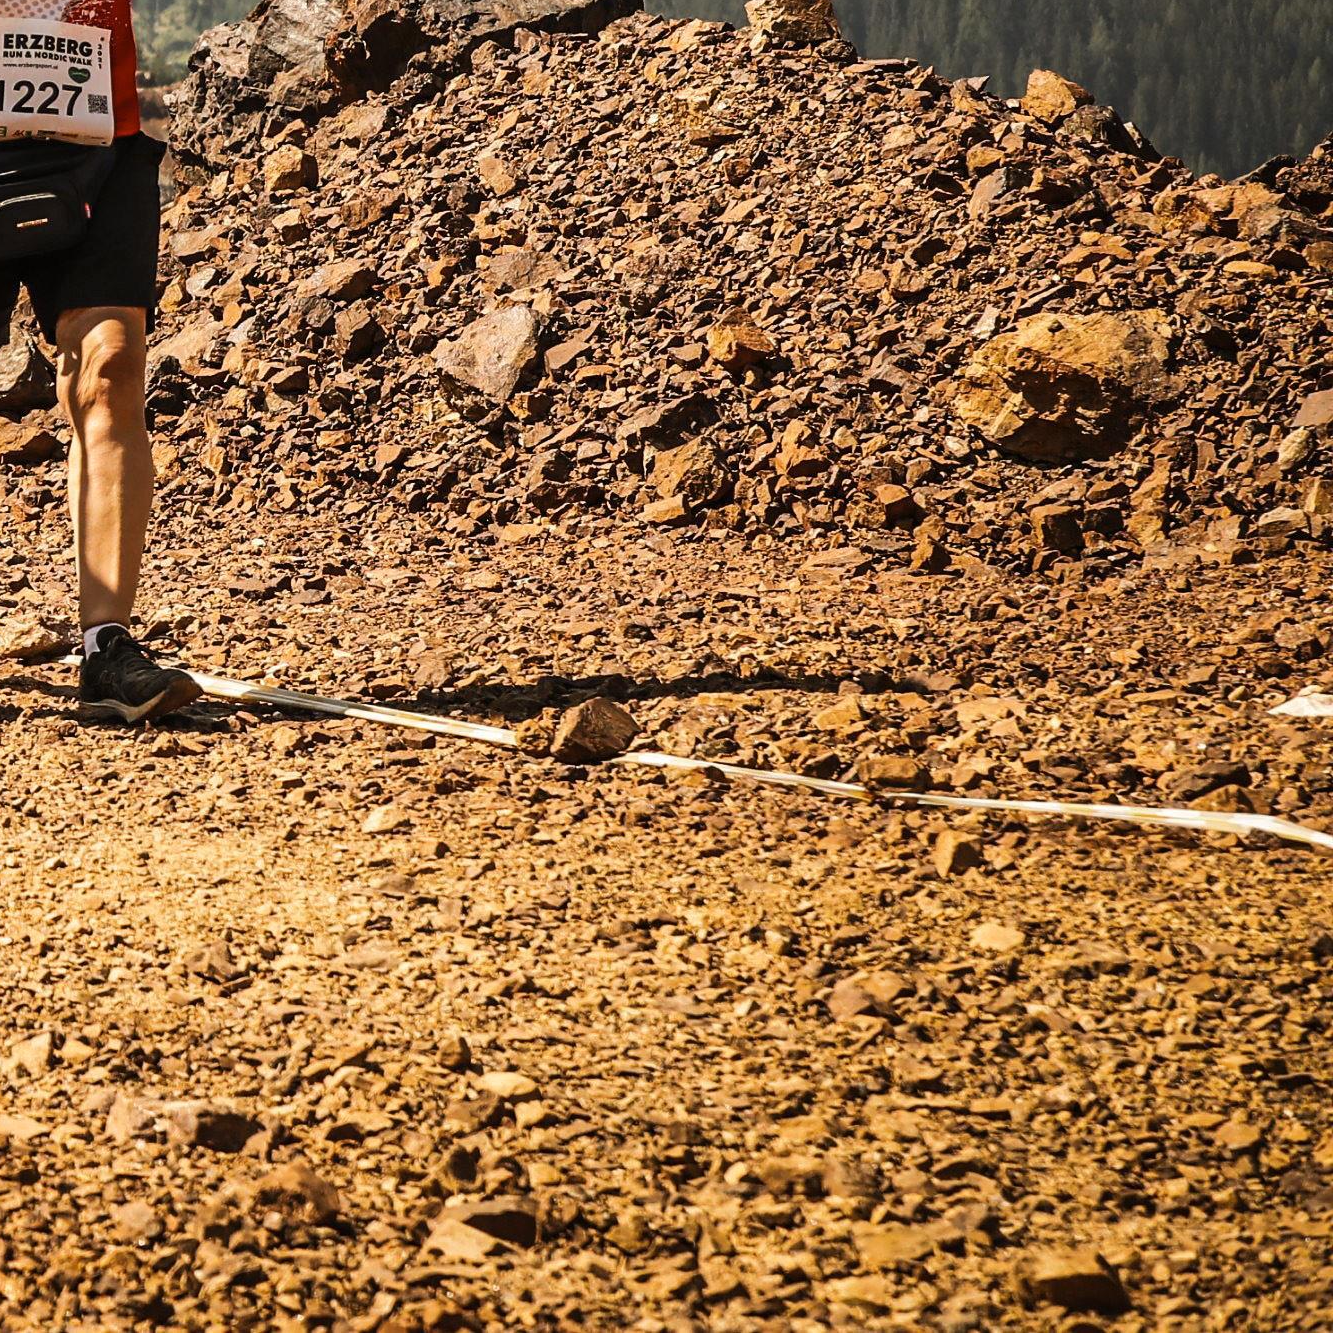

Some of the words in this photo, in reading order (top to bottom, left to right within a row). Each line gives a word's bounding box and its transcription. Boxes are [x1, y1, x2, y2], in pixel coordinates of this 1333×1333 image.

[3, 33, 93, 57] ERZBERG
[2, 51, 23, 59] RUN
[24, 51, 32, 59] &
[34, 52, 68, 62] NORDIC
[68, 56, 93, 67] WALK
